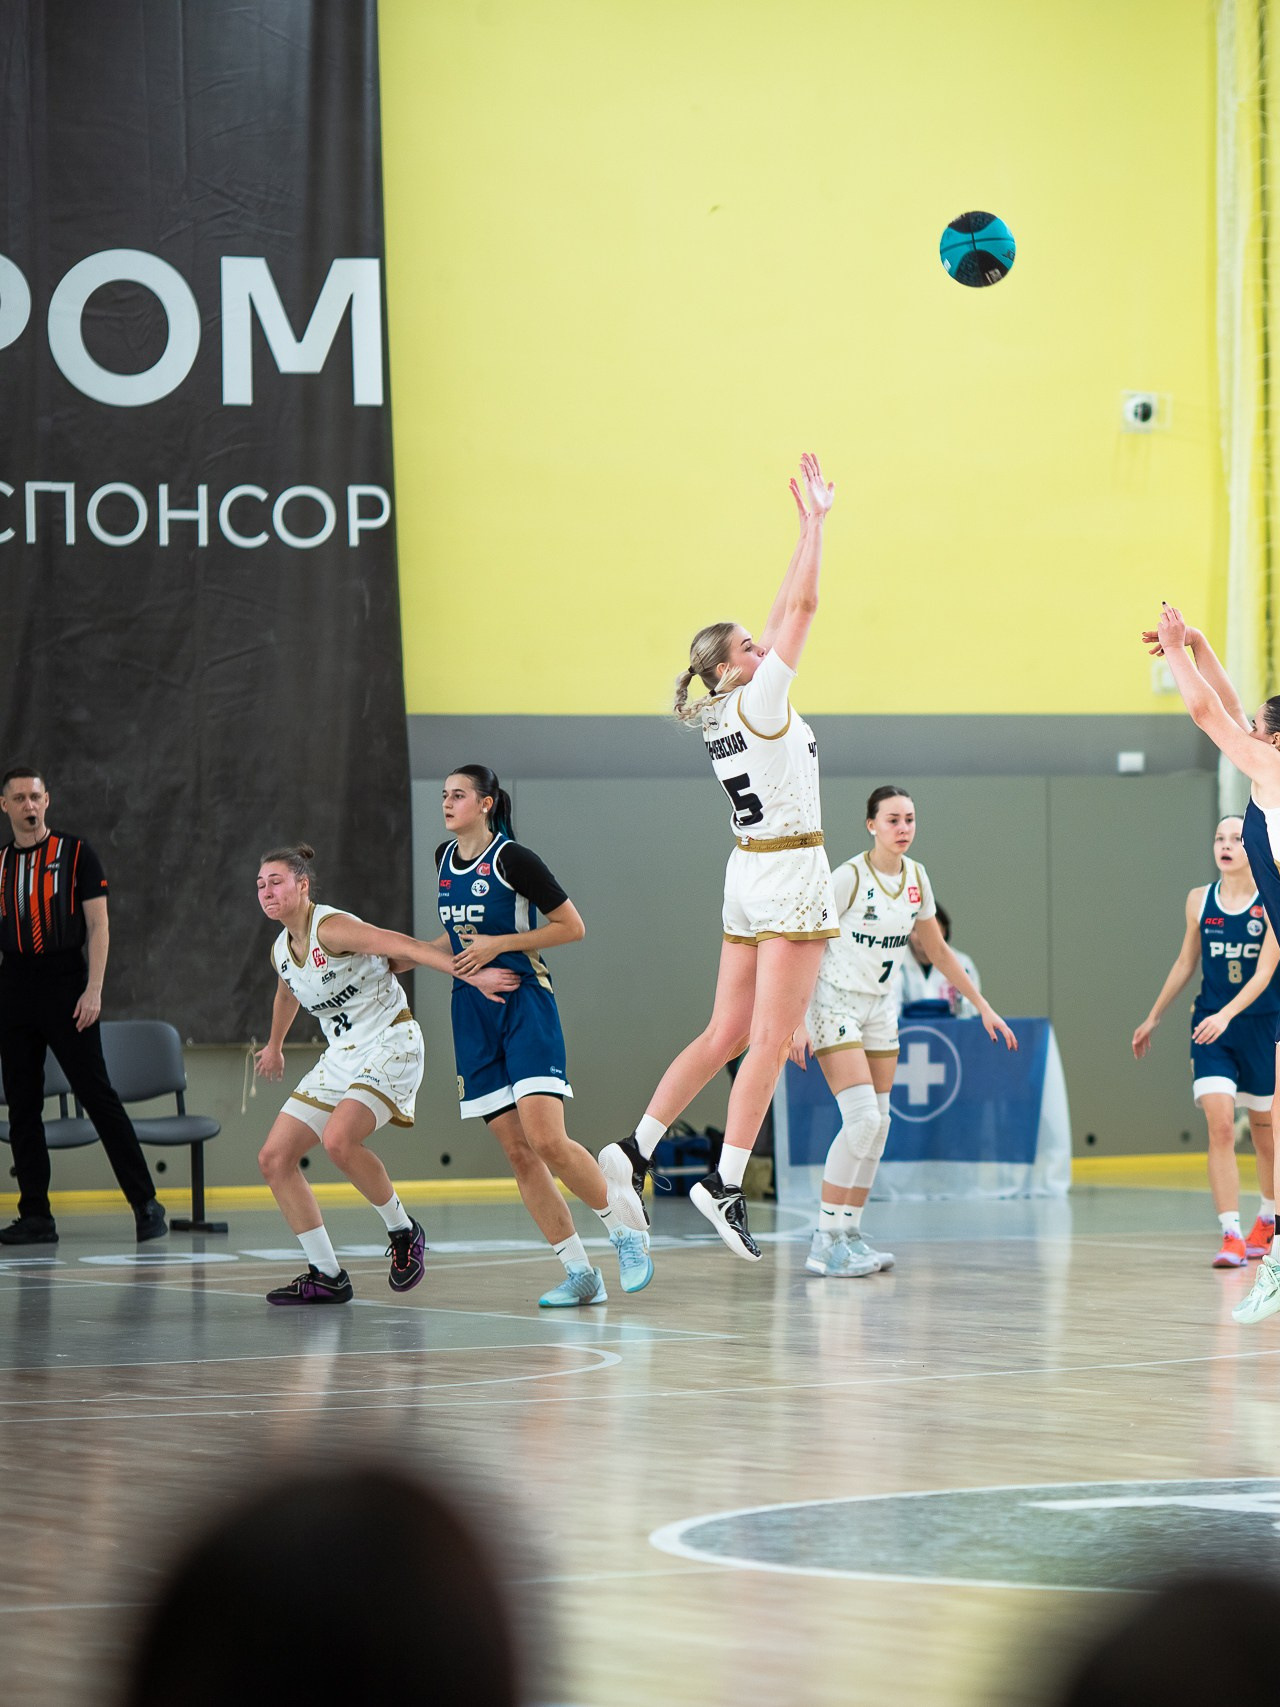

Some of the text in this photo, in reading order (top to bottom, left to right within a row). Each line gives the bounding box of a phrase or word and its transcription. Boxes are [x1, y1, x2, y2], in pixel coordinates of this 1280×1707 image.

[0, 248, 384, 408] ОМ
[0, 481, 392, 549] ПОНСОР
[722, 772, 764, 827] 5
[439, 904, 486, 924] РУС
[1209, 941, 1261, 958] РУС
[878, 960, 894, 983] 7
[1228, 960, 1243, 984] 8
